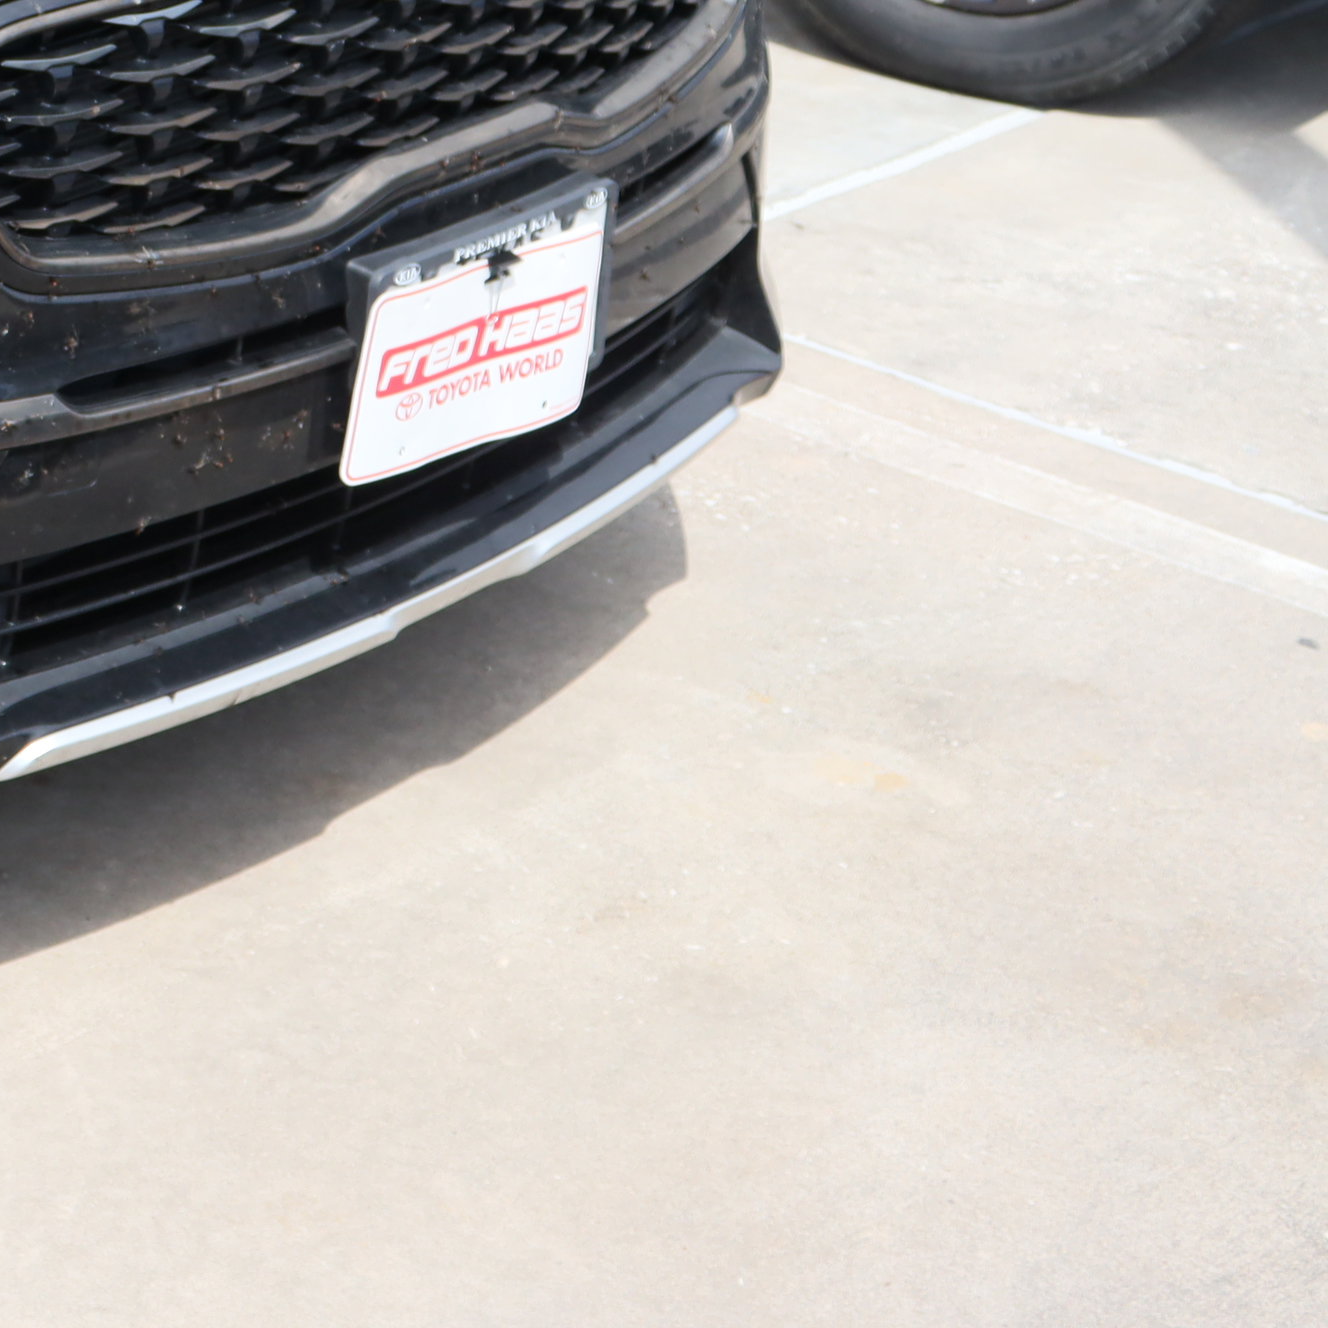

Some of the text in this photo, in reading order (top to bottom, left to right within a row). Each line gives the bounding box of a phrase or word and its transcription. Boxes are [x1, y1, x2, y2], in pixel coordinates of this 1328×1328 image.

[454, 210, 557, 263] PREMIER KIA
[428, 348, 564, 409] TOYOTA WORLD
